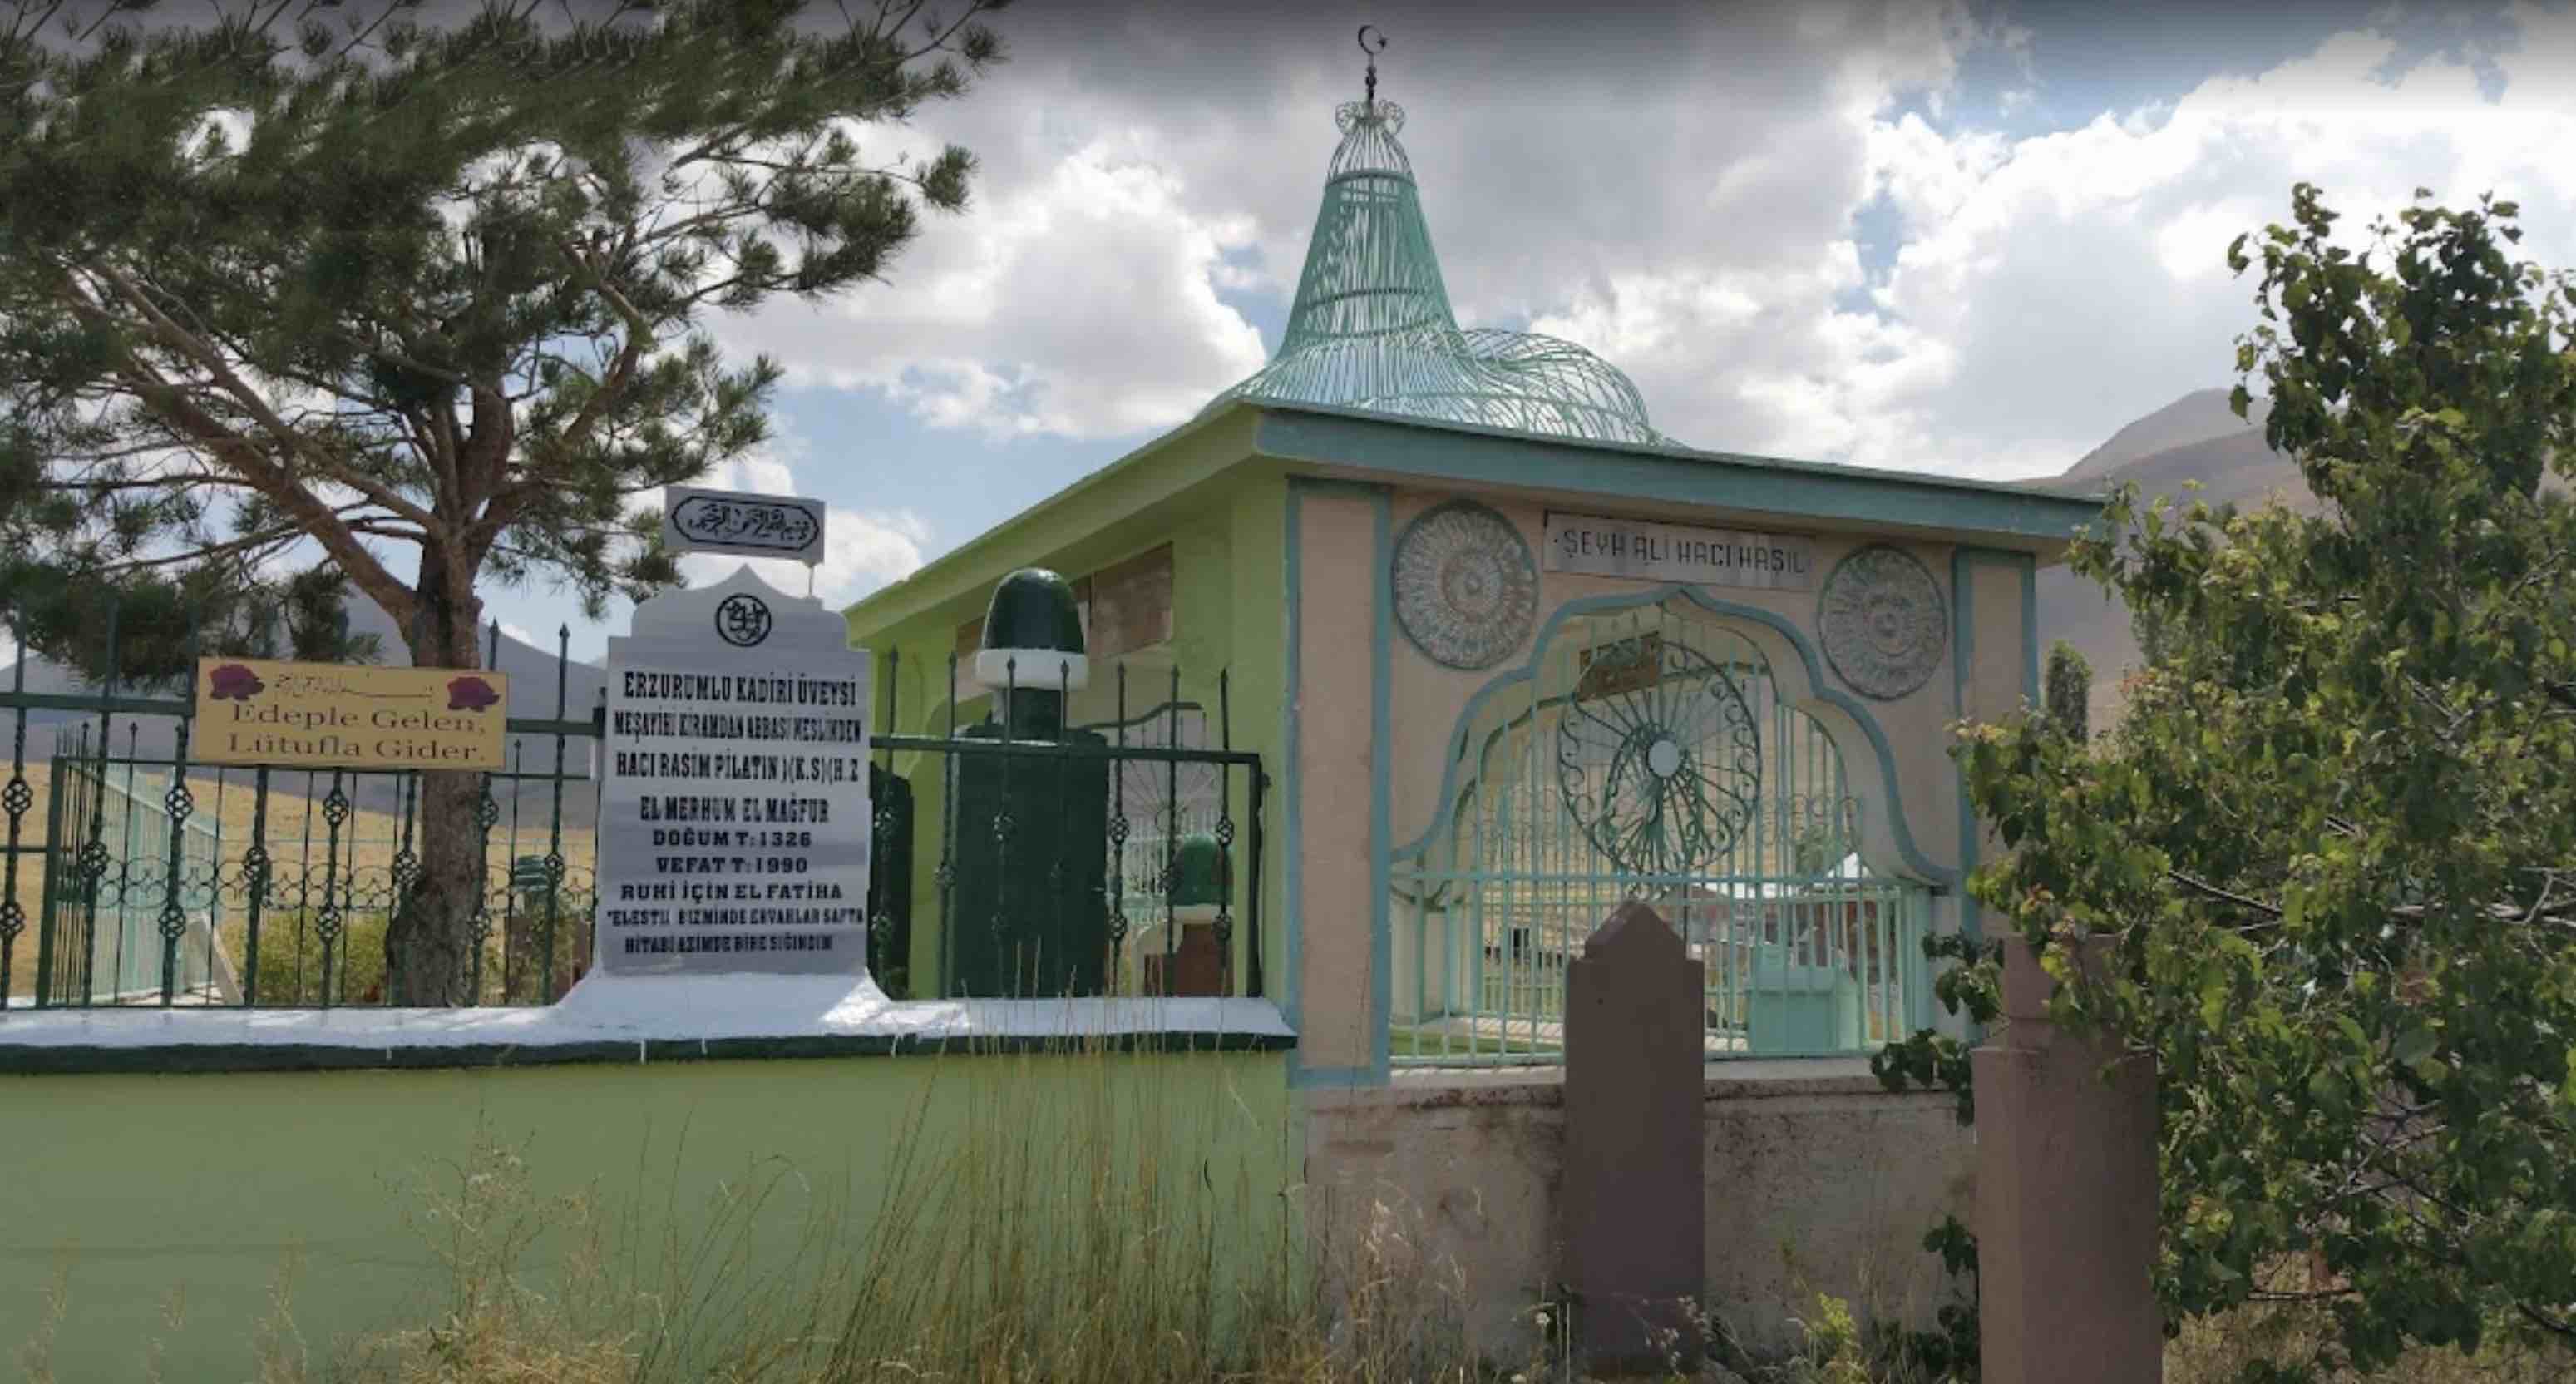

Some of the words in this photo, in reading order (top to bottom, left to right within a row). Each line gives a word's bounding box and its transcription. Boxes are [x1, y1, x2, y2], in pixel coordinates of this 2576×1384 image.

[1563, 529, 1623, 558] ŞEYH
[1677, 541, 1730, 567] HACI
[624, 670, 731, 702] ERZURUMLU
[232, 703, 360, 731] Edeple
[371, 709, 486, 735] Gelen,
[229, 733, 361, 759] Lütufla
[375, 738, 486, 762] Gider.
[617, 751, 655, 778] HACI
[660, 747, 710, 778] RASİM
[640, 795, 662, 823] EL
[743, 797, 762, 823] EL
[652, 827, 729, 848] DOĞUM
[656, 856, 726, 874] VEFAT
[620, 879, 676, 902] RUHİ
[682, 879, 729, 904] İÇİN
[734, 883, 762, 900] EL
[767, 880, 843, 901] FATİHA
